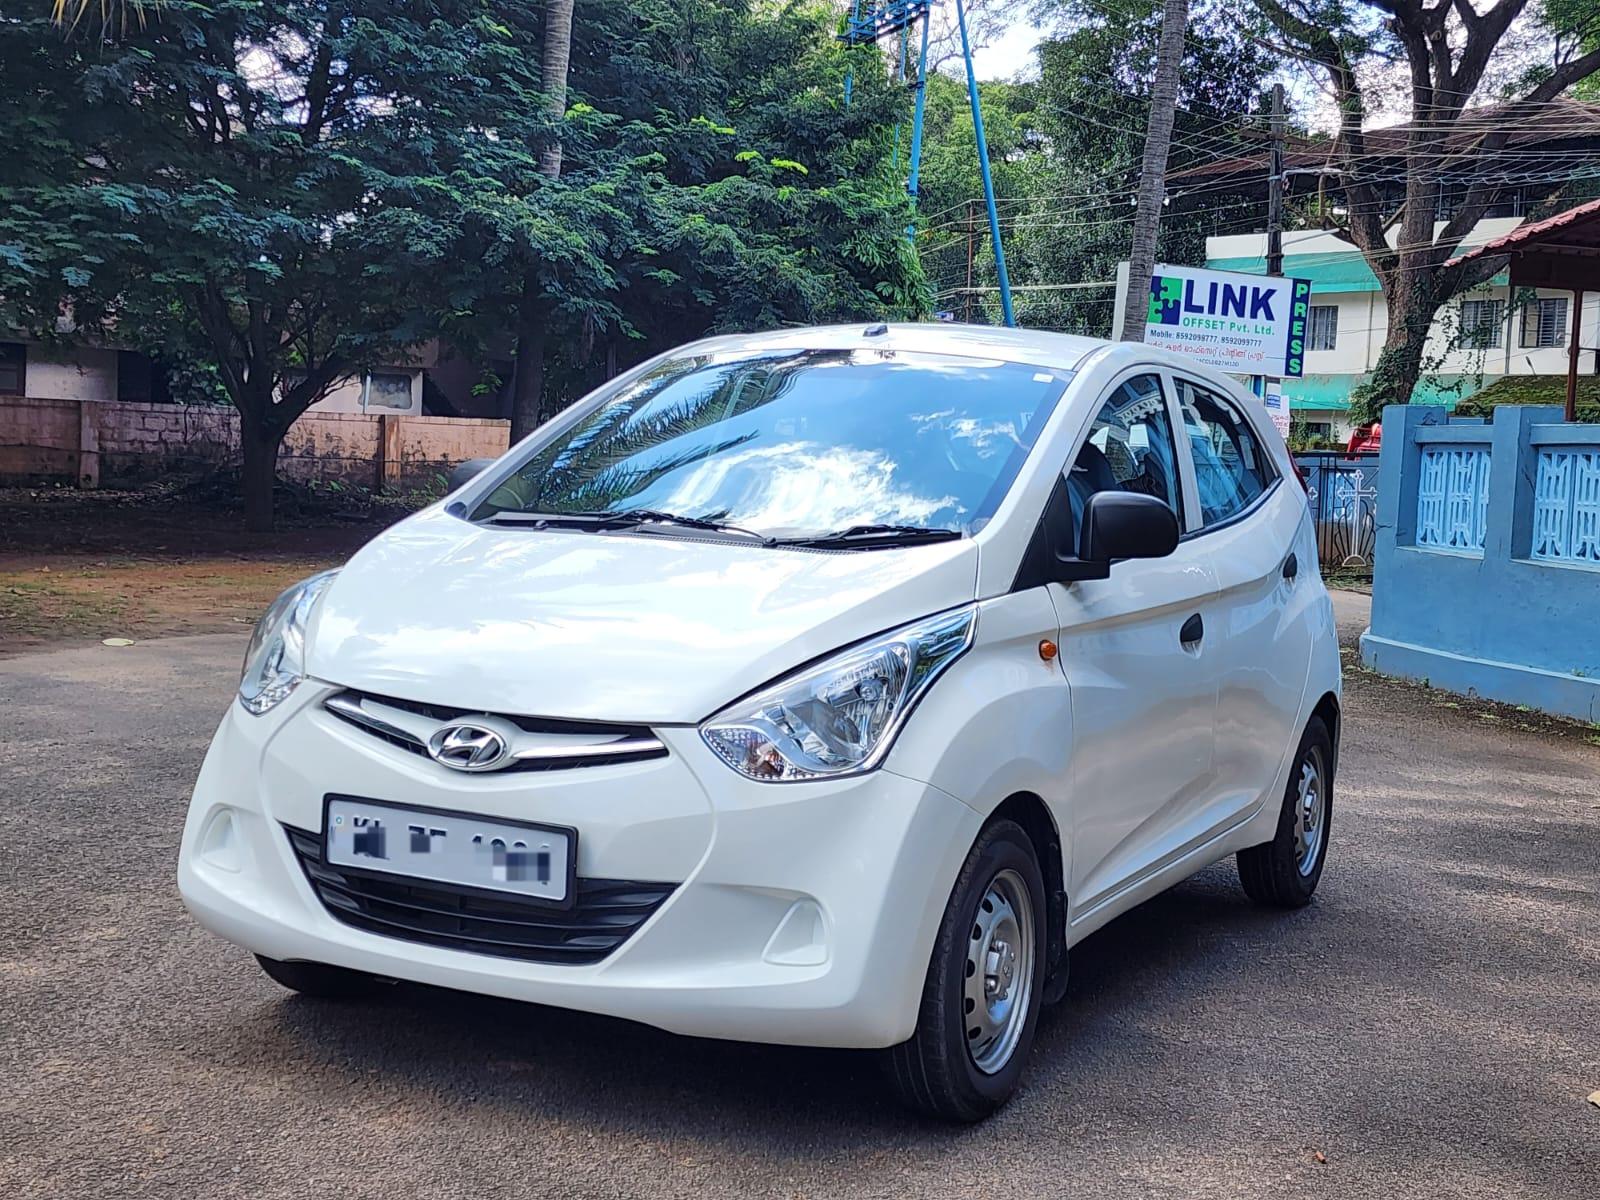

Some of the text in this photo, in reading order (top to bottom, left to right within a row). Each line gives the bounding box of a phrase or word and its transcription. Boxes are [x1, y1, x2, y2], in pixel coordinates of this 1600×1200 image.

[1184, 279, 1278, 321] LINK
[1150, 329, 1174, 339] Mobile:
[1183, 317, 1275, 335] OFFSET Pvt. Ltd.
[1289, 283, 1308, 374] PRESS
